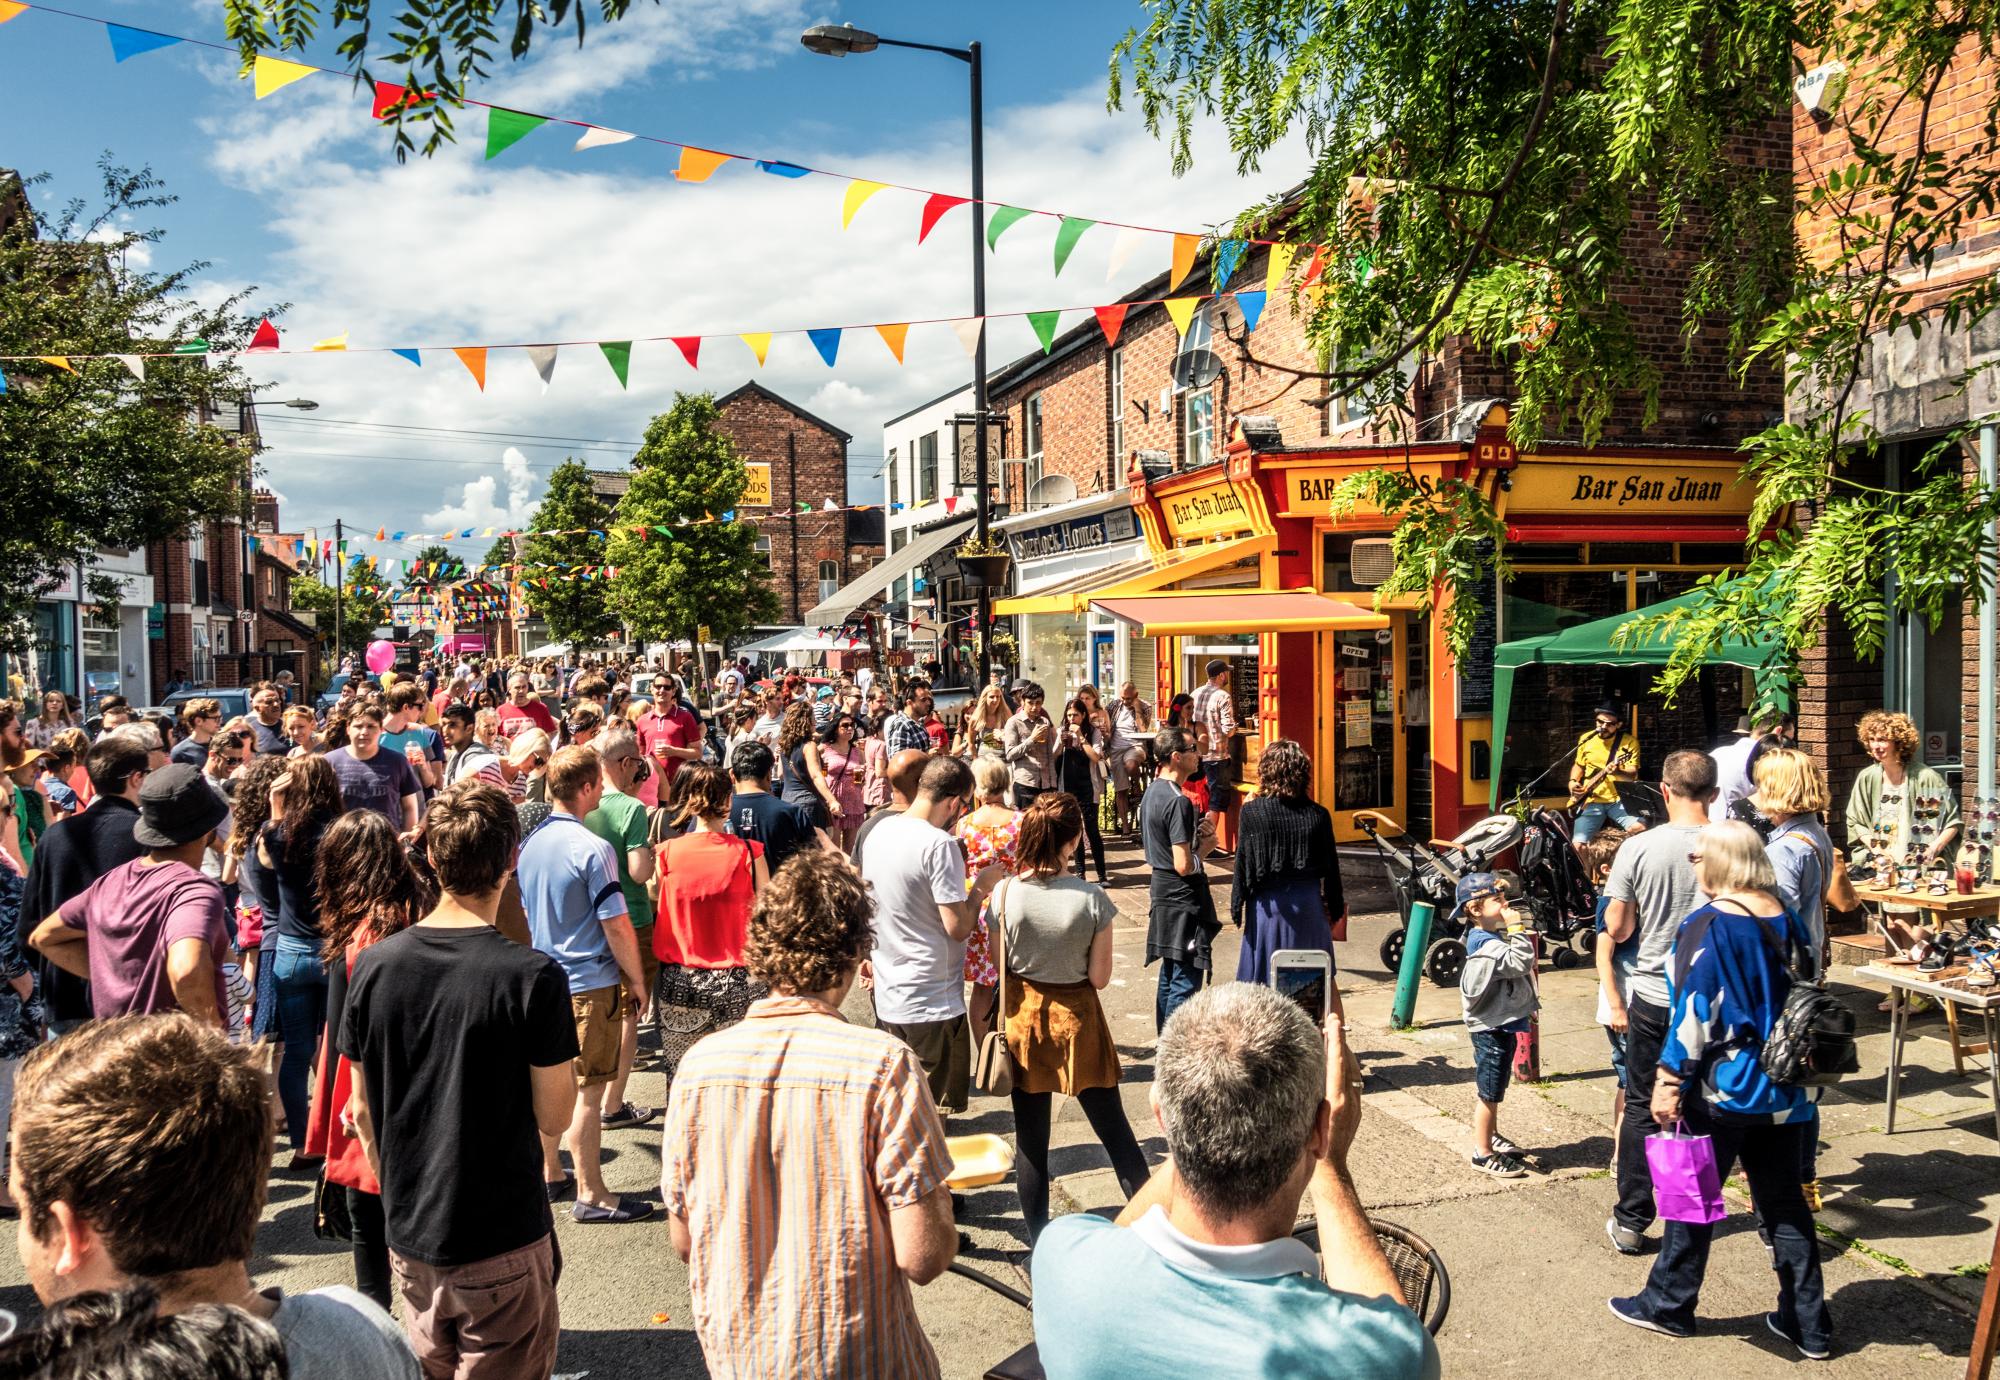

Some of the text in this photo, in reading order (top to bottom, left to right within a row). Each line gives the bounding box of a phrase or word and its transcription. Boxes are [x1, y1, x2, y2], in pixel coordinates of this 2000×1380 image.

[1798, 72, 1825, 90] HBA
[1299, 478, 1335, 500] BAR
[1571, 475, 1723, 506] Bar San Juan
[1172, 492, 1241, 525] Bar San Juan
[1014, 522, 1105, 559] Sherlock Homes
[1346, 647, 1364, 656] OPEN
